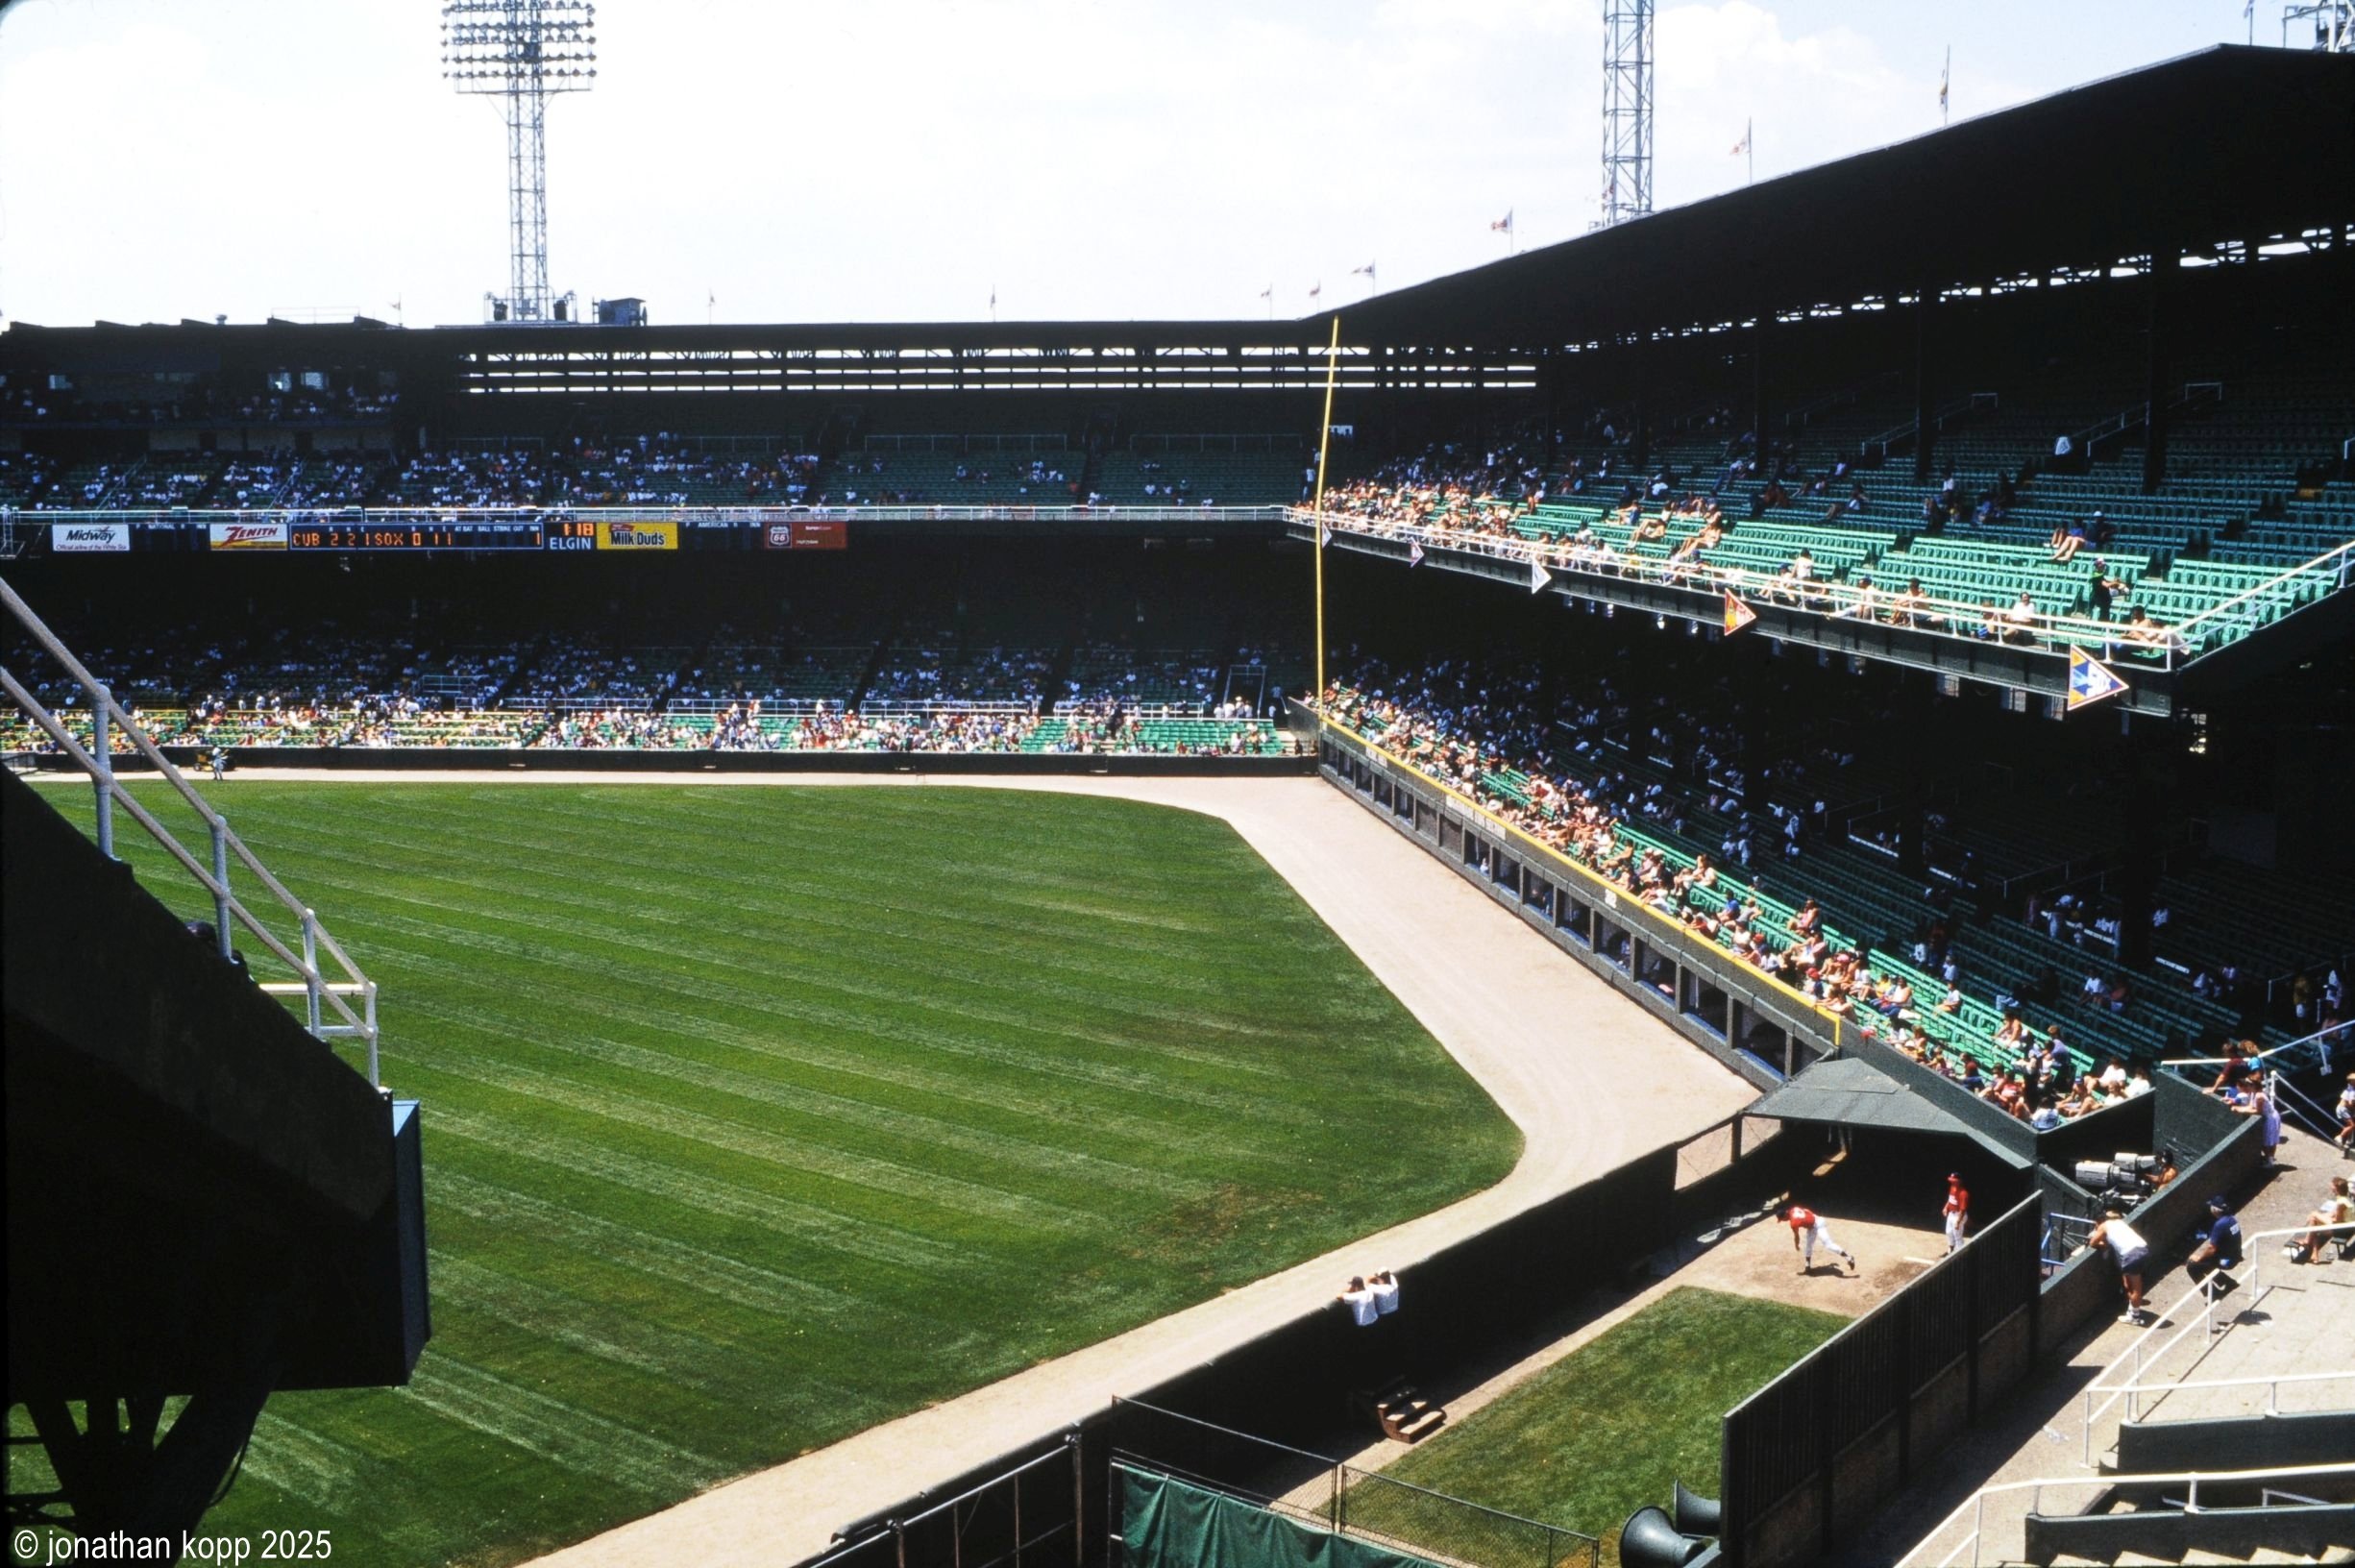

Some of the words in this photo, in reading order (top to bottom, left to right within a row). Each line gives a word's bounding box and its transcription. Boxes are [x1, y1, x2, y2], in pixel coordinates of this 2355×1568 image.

[66, 529, 115, 544] Midway
[219, 527, 279, 548] ZENITH
[293, 532, 320, 547] CUB
[331, 532, 338, 547] 2
[348, 532, 356, 547] 2
[375, 532, 404, 547] SOX
[412, 532, 421, 547] 0
[549, 537, 591, 551] ELGIN
[611, 530, 634, 546] Milk
[636, 531, 665, 546] Duds
